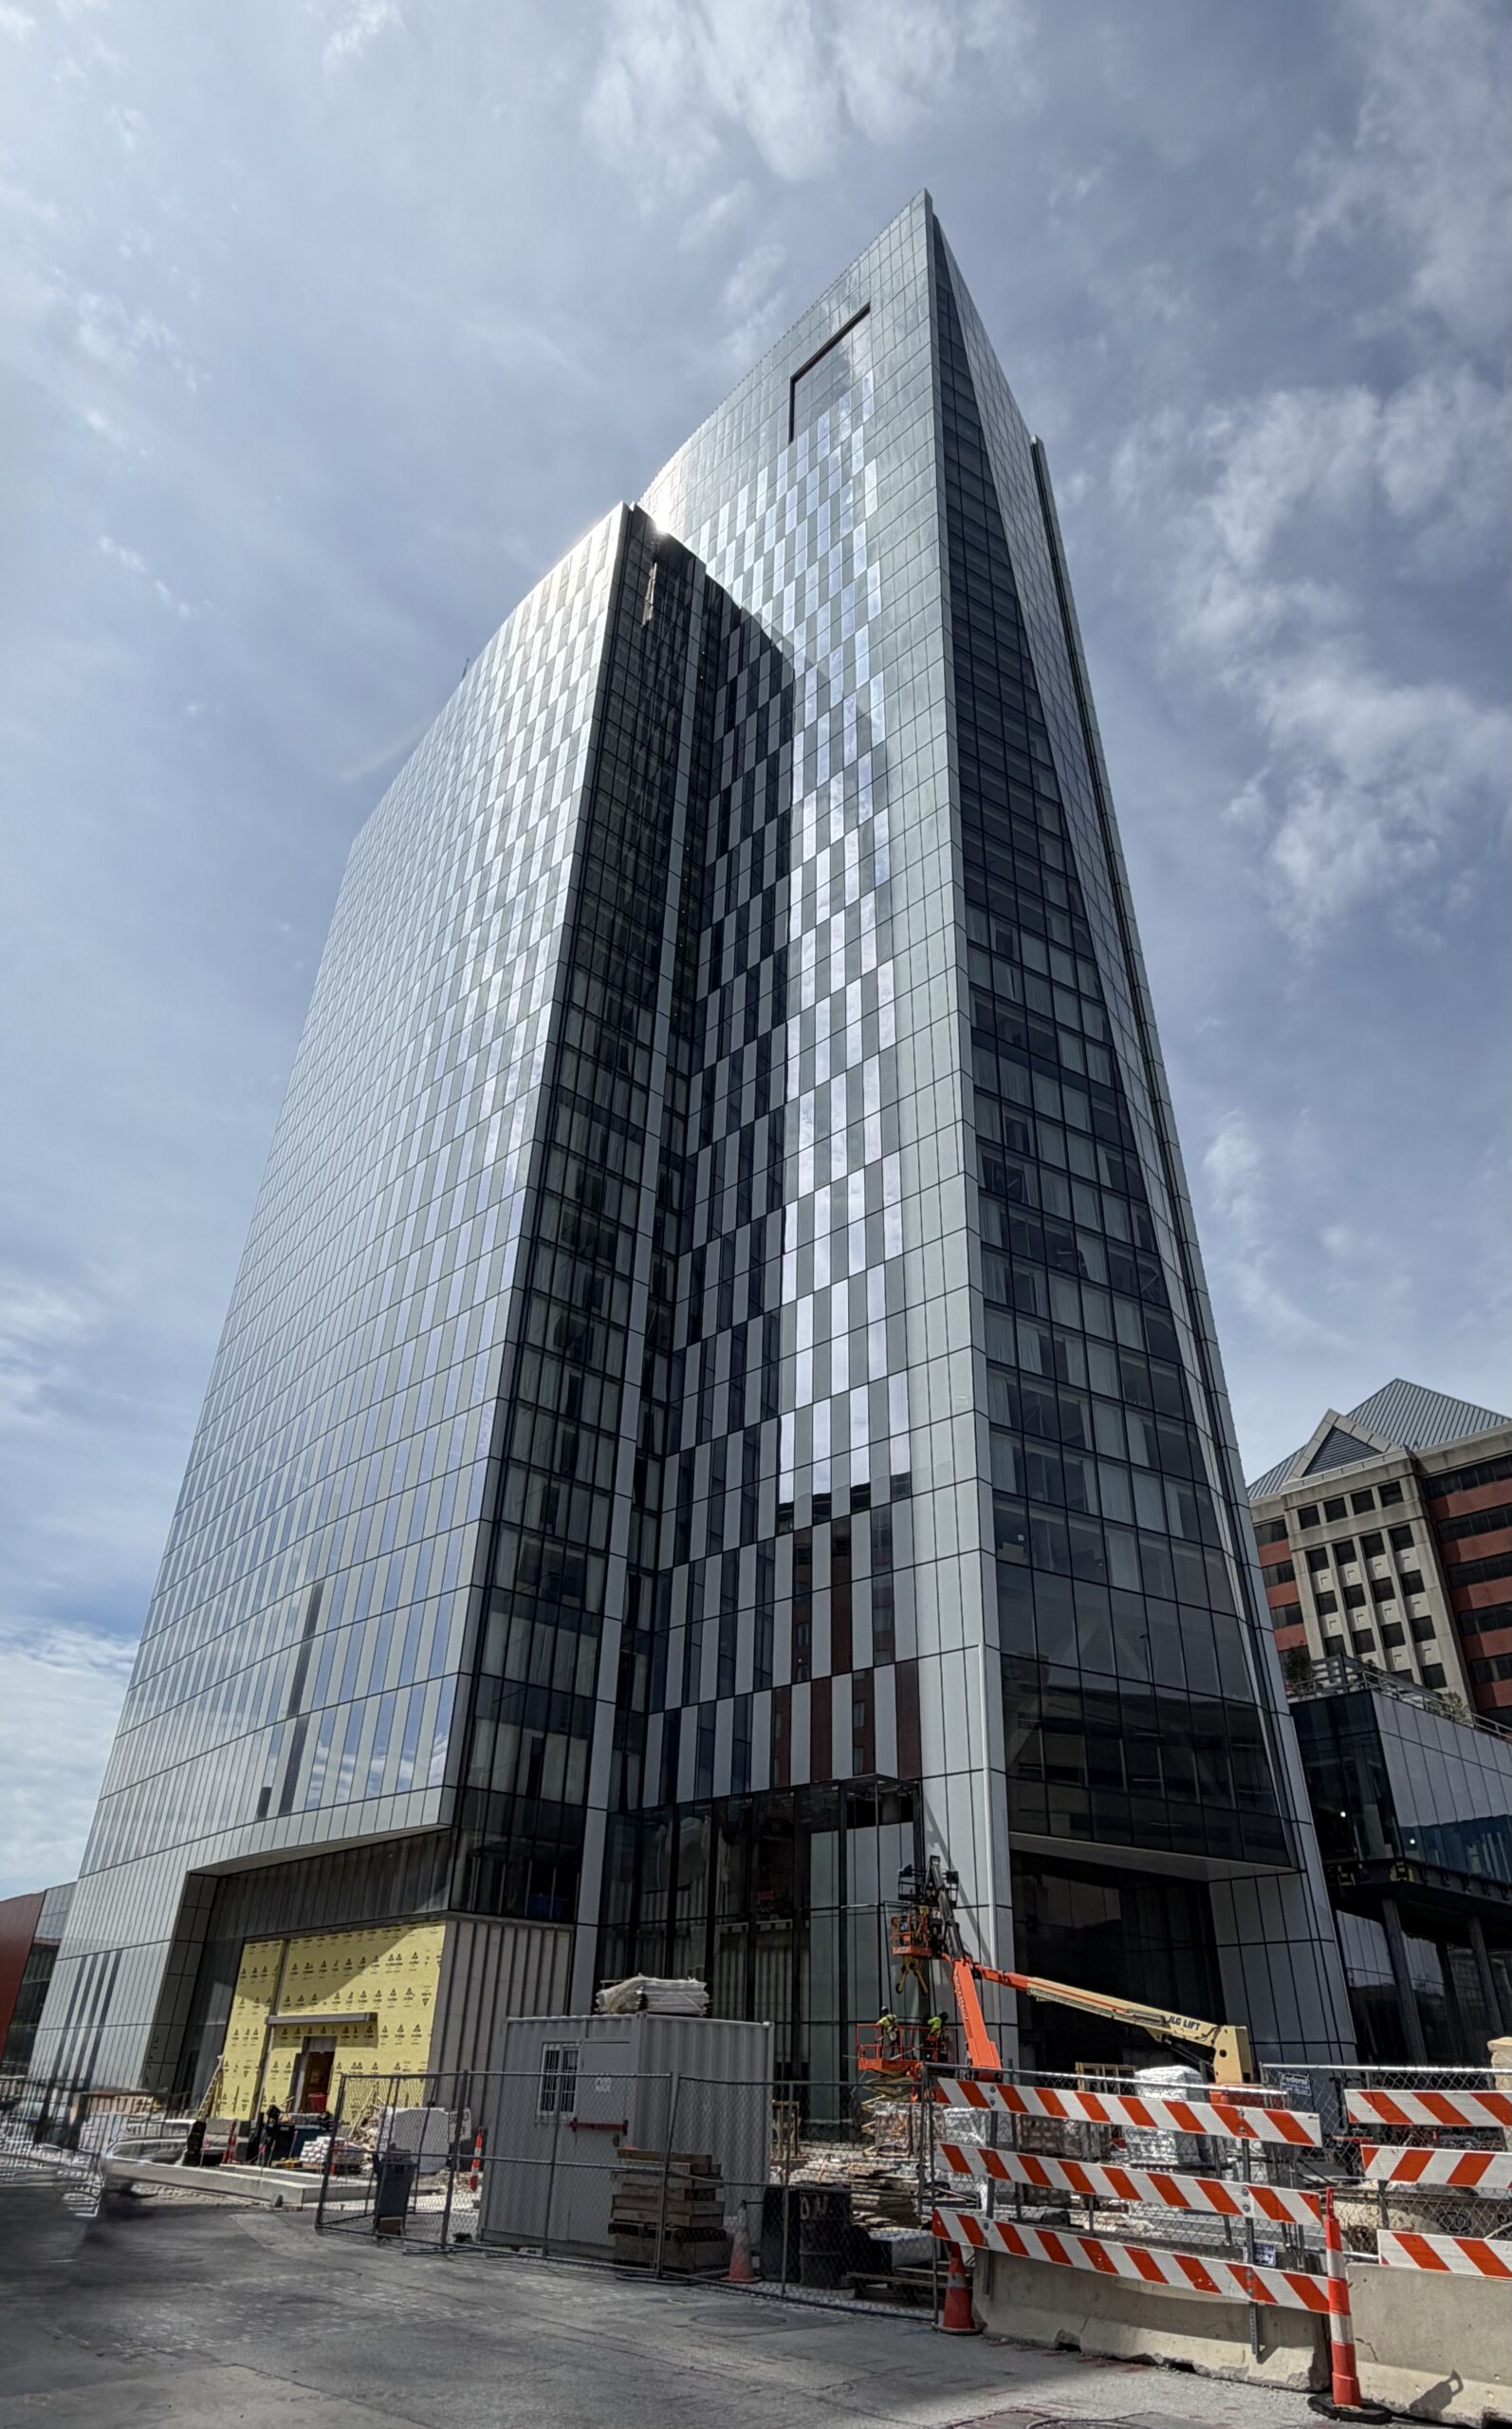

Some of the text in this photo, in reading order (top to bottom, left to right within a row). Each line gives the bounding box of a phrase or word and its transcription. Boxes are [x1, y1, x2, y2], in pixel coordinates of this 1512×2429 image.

[1169, 2015, 1201, 2030] JLG LIFT
[1281, 2073, 1308, 2086] Federal
